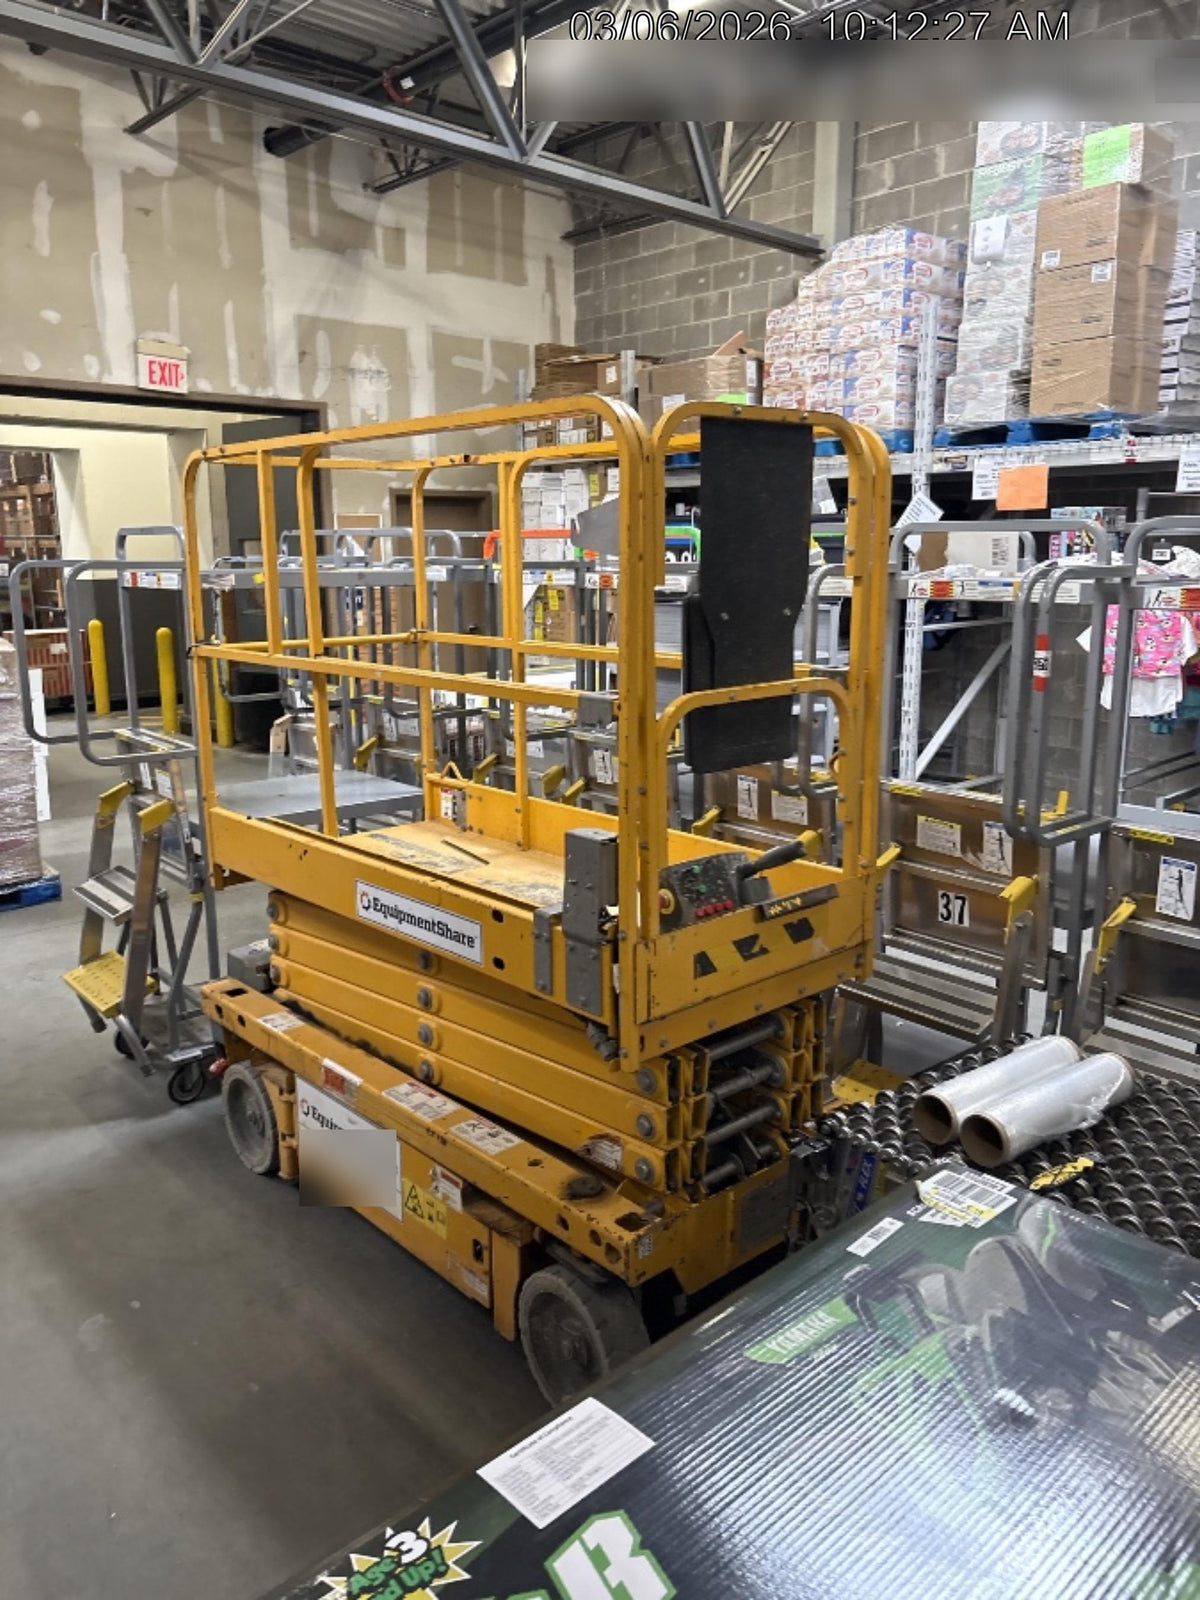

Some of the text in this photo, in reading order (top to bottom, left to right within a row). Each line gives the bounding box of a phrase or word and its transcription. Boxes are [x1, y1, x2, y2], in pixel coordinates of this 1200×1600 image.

[148, 360, 180, 388] EXIT
[372, 896, 476, 948] EquipmentShare
[940, 892, 967, 925] 37
[349, 1530, 429, 1596] Age 3
[400, 1547, 448, 1588] Up!
